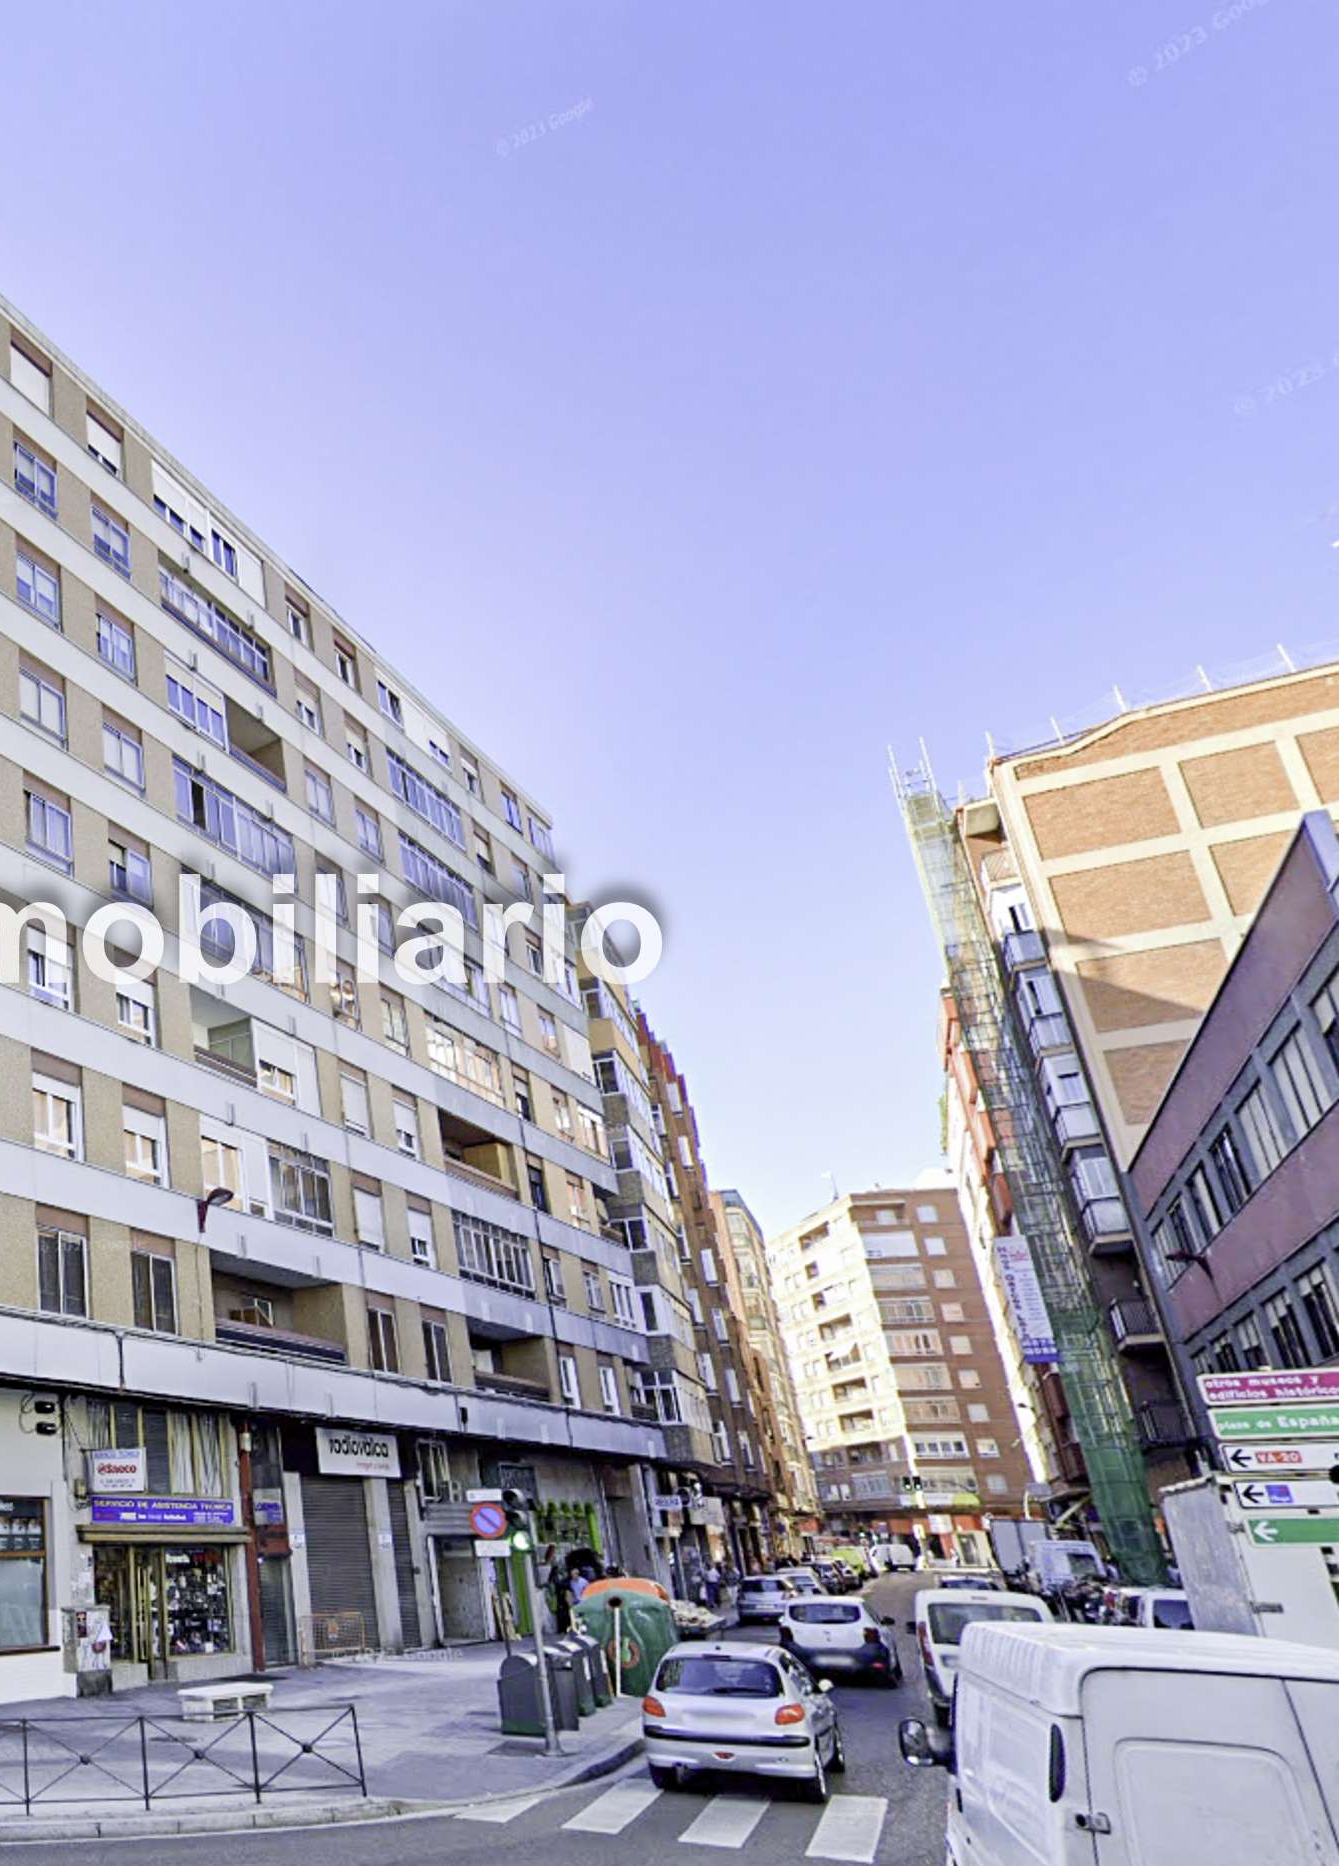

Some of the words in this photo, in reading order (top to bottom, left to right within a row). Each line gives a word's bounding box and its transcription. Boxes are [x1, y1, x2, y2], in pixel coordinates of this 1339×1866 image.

[1247, 1376, 1303, 1387] museos
[1207, 1388, 1269, 1400] edificios
[137, 1501, 149, 1509] DE
